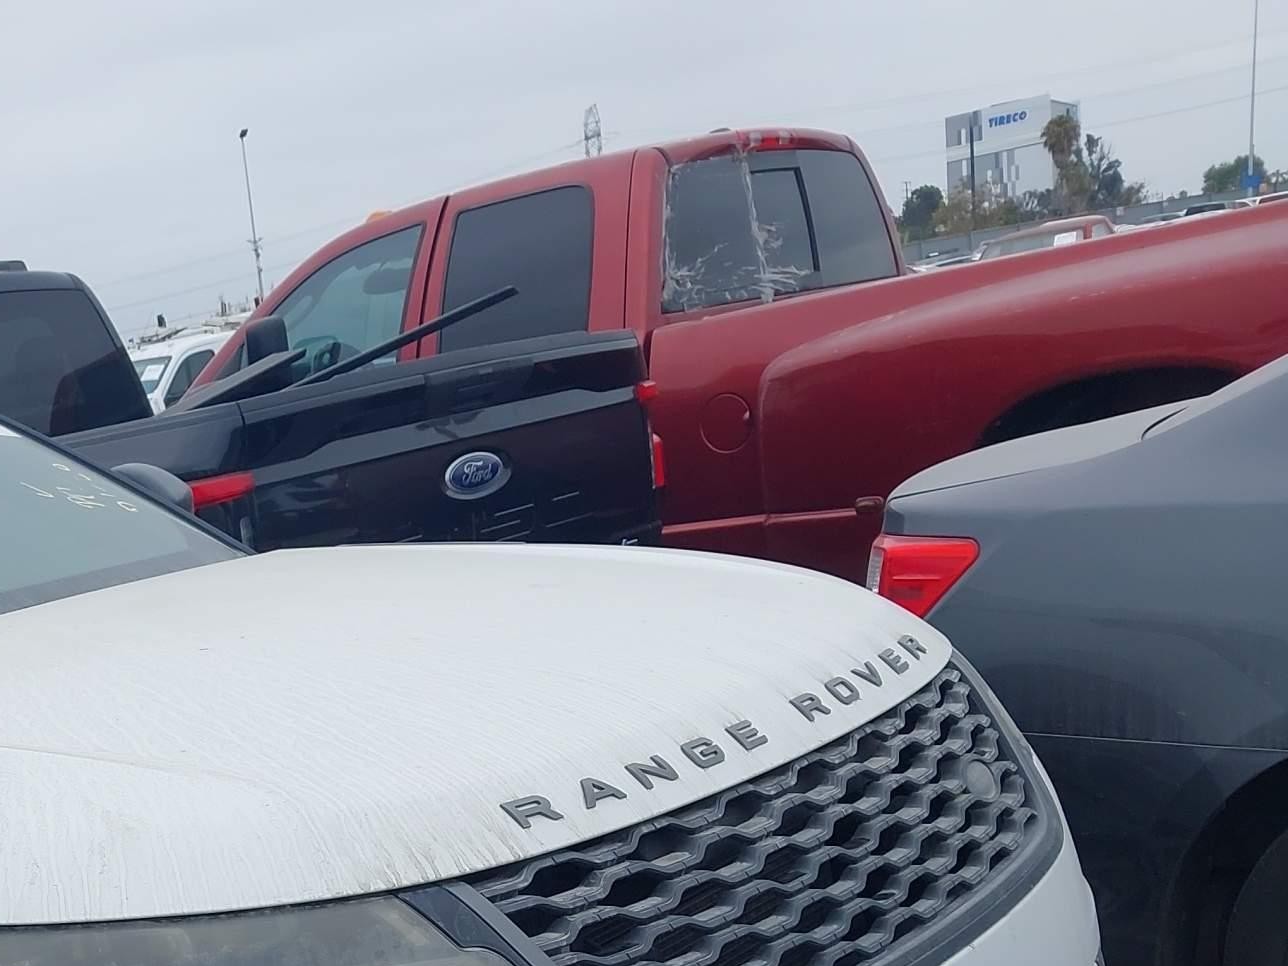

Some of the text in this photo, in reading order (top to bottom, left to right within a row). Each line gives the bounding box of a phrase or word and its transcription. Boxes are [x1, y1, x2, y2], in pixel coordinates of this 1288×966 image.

[988, 111, 1028, 128] TIRECO
[462, 461, 493, 486] Ford
[500, 633, 928, 829] RANGE ROVER
